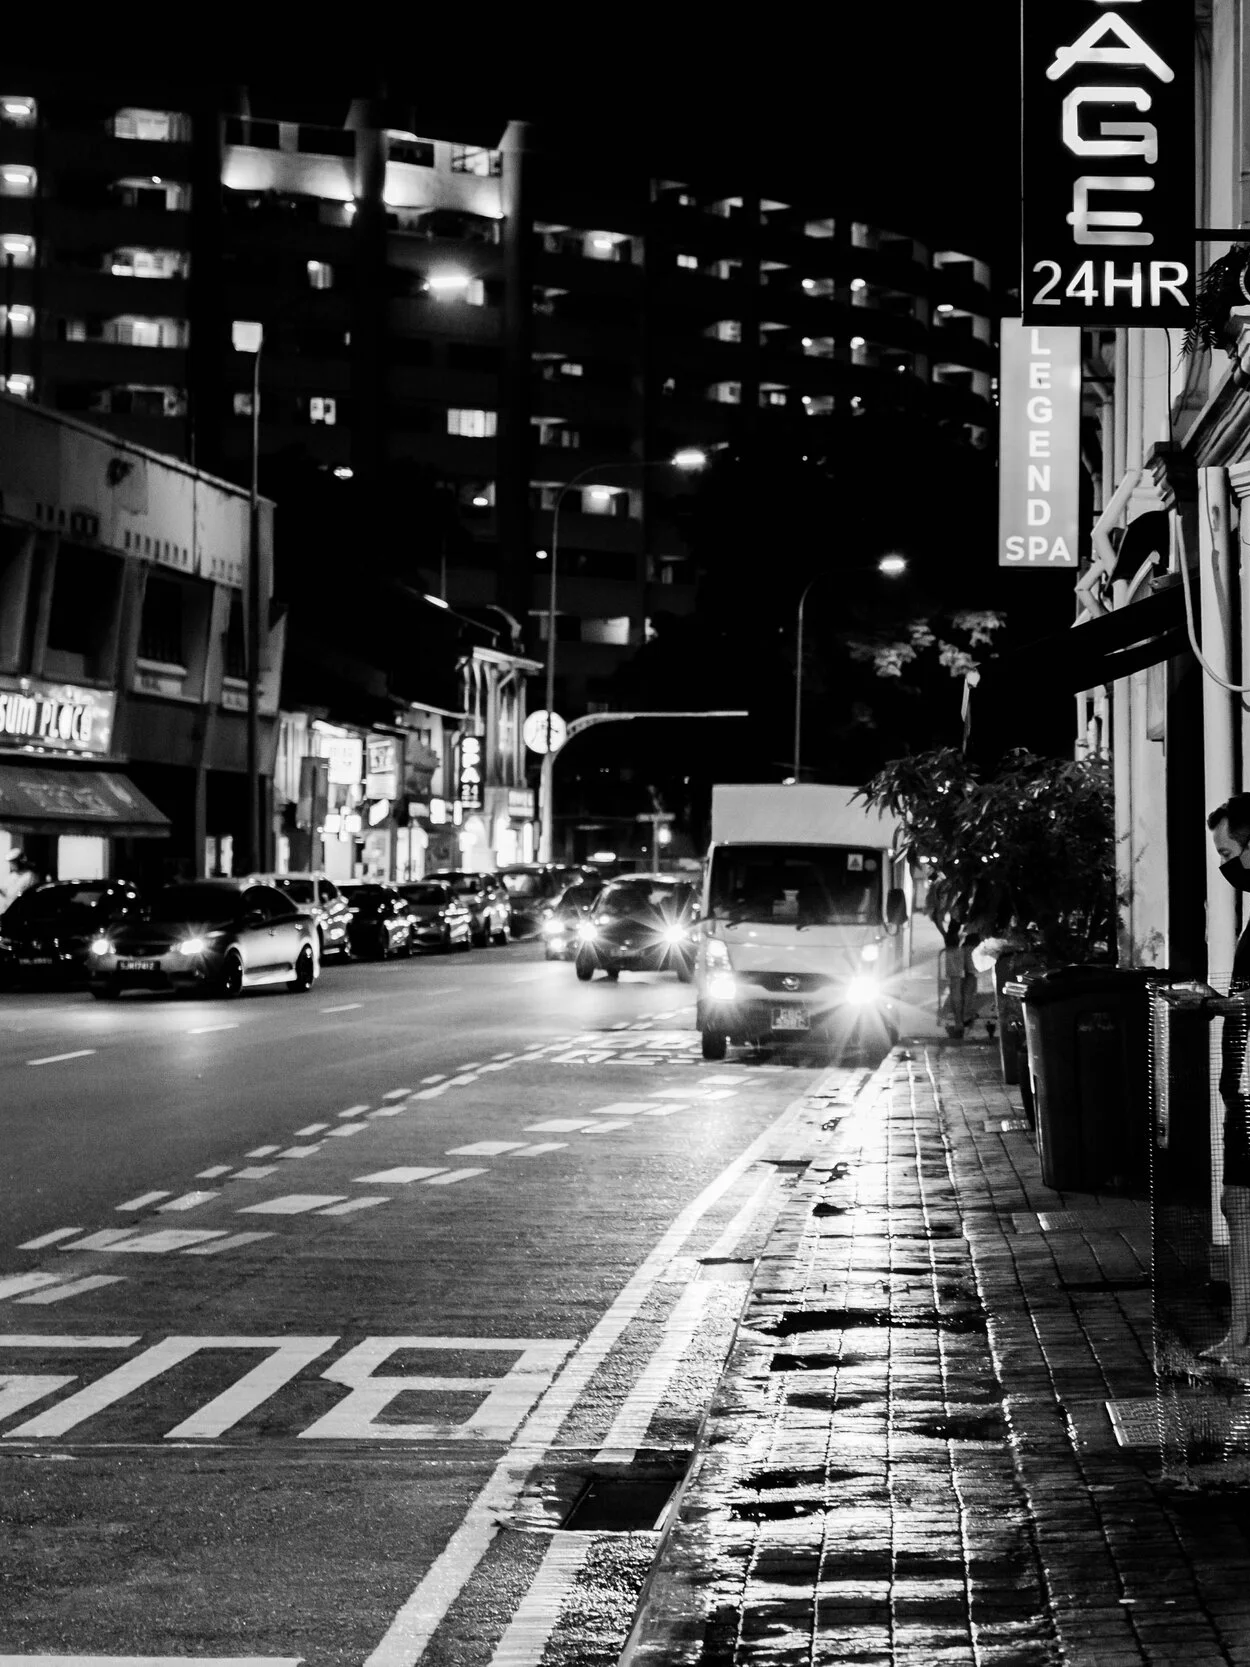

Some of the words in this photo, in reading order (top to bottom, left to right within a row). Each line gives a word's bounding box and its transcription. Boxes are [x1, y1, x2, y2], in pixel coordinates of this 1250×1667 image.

[1046, 0, 1174, 245] AGE
[1032, 260, 1190, 307] 24HR
[1026, 329, 1053, 527] LEGEND
[1005, 536, 1072, 562] SPA
[461, 737, 481, 783] SPA
